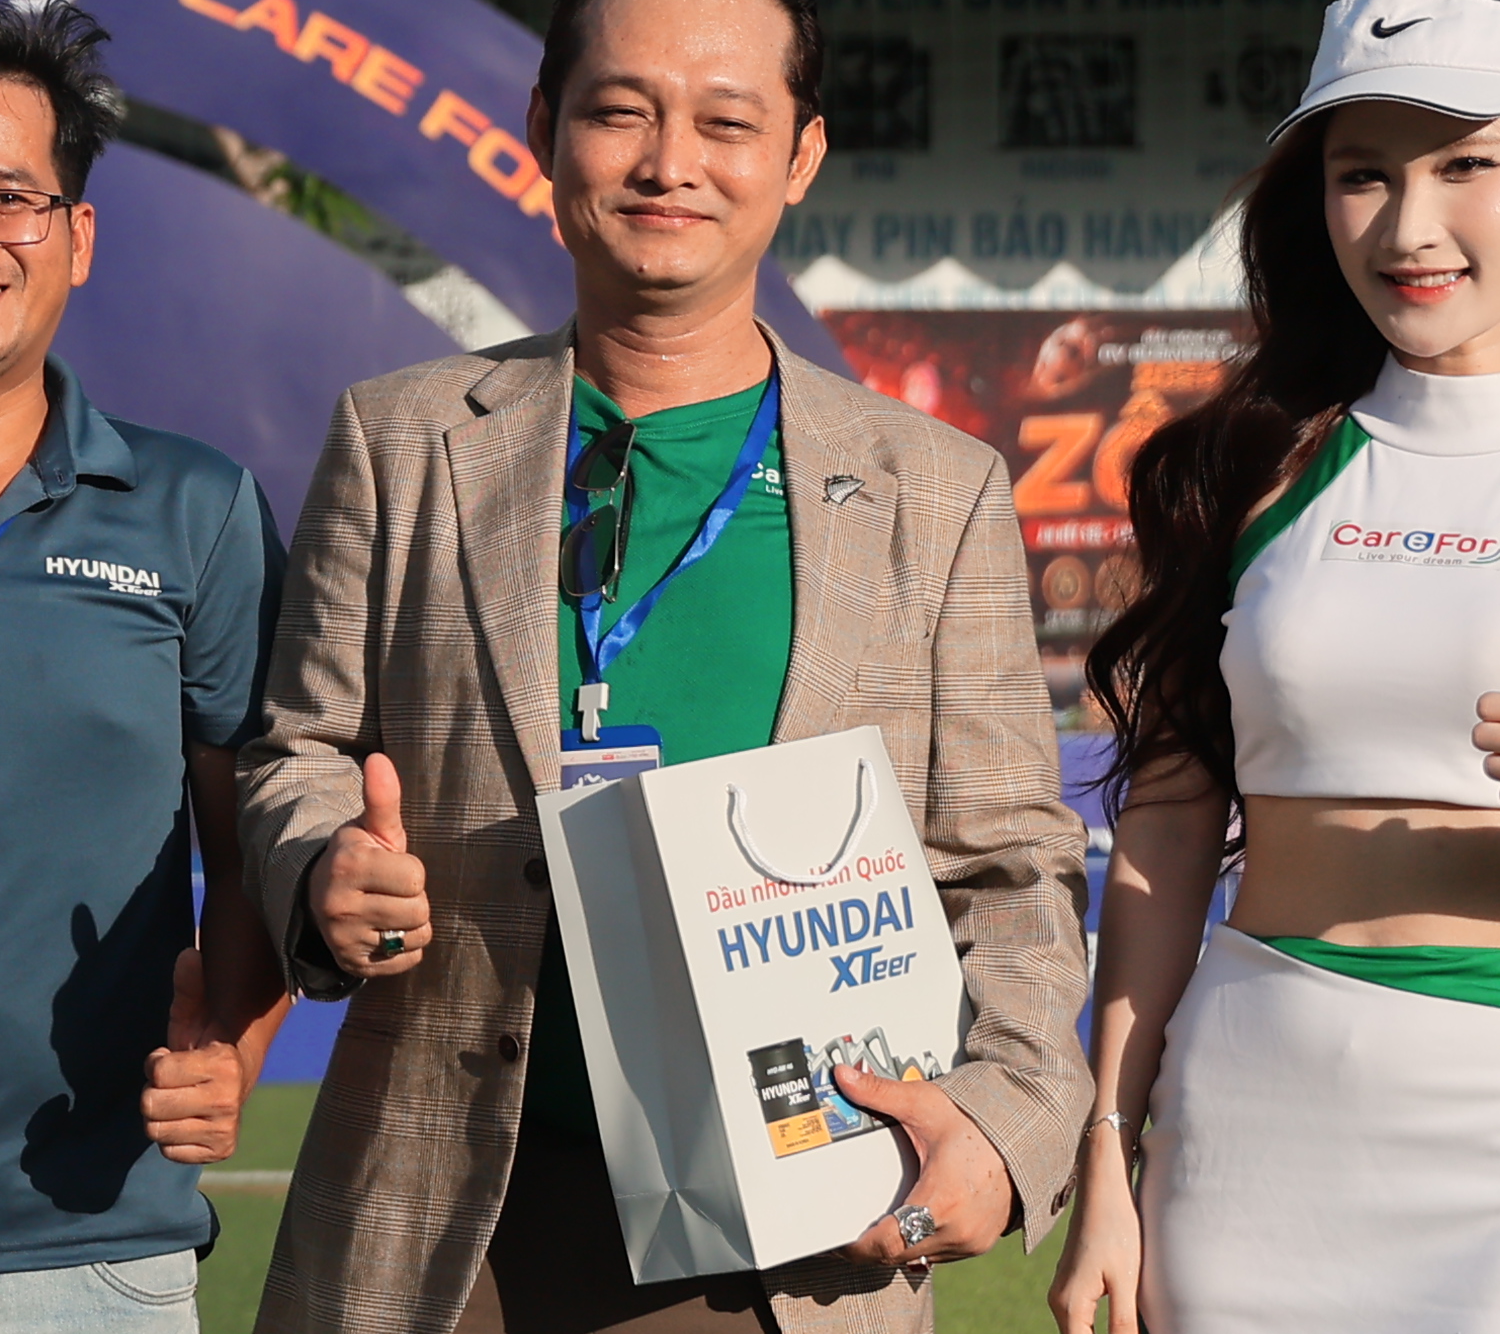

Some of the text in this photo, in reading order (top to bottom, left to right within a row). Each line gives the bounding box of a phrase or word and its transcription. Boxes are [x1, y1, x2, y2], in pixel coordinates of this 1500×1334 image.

[872, 211, 950, 260] PIN
[45, 556, 161, 589] HYUNDAI
[1357, 552, 1463, 566] Live your dream
[705, 885, 747, 913] Dầu
[856, 846, 906, 882] Quốc
[717, 885, 914, 973] HYUNDAI
[829, 944, 918, 994] XTeer
[761, 1077, 810, 1101] HYUNDAI
